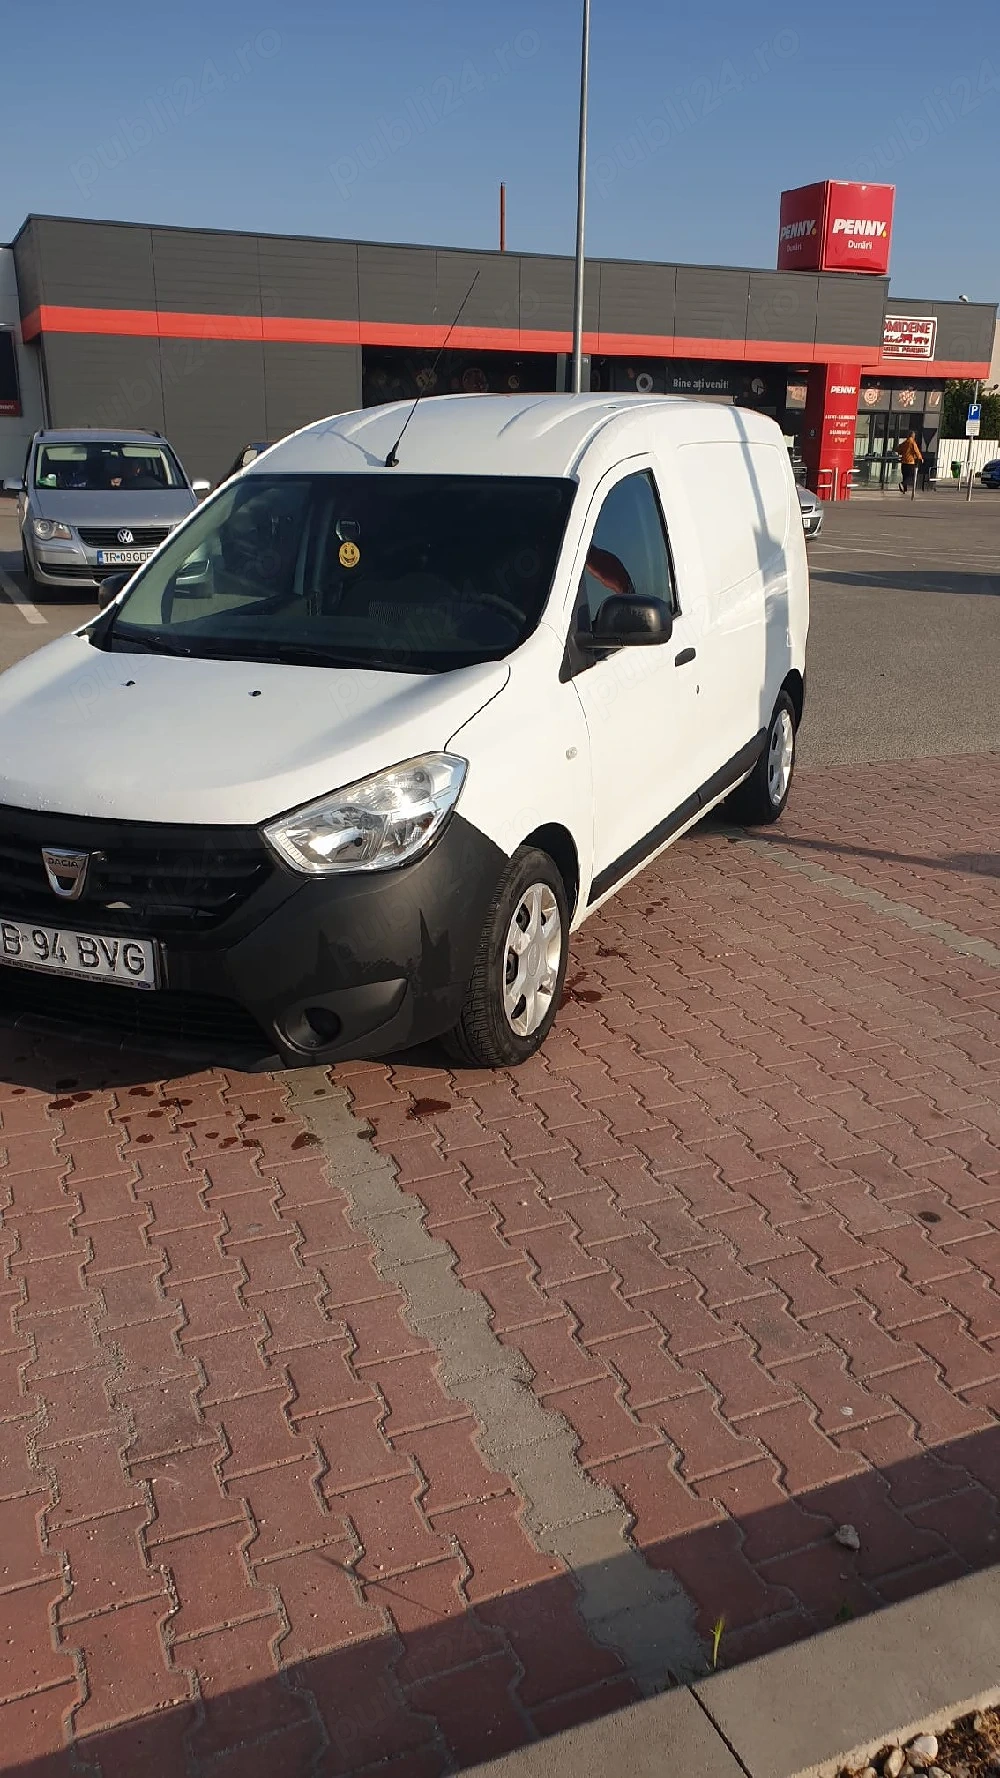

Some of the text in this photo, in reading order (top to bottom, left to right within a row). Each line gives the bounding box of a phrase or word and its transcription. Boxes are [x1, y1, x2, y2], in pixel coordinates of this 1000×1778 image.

[673, 377, 692, 388] Bine
[104, 552, 117, 563] TR
[120, 552, 132, 562] 09
[46, 857, 79, 869] DACIA
[1, 922, 22, 955] B
[32, 929, 68, 965] 94
[76, 935, 146, 976] BVG
